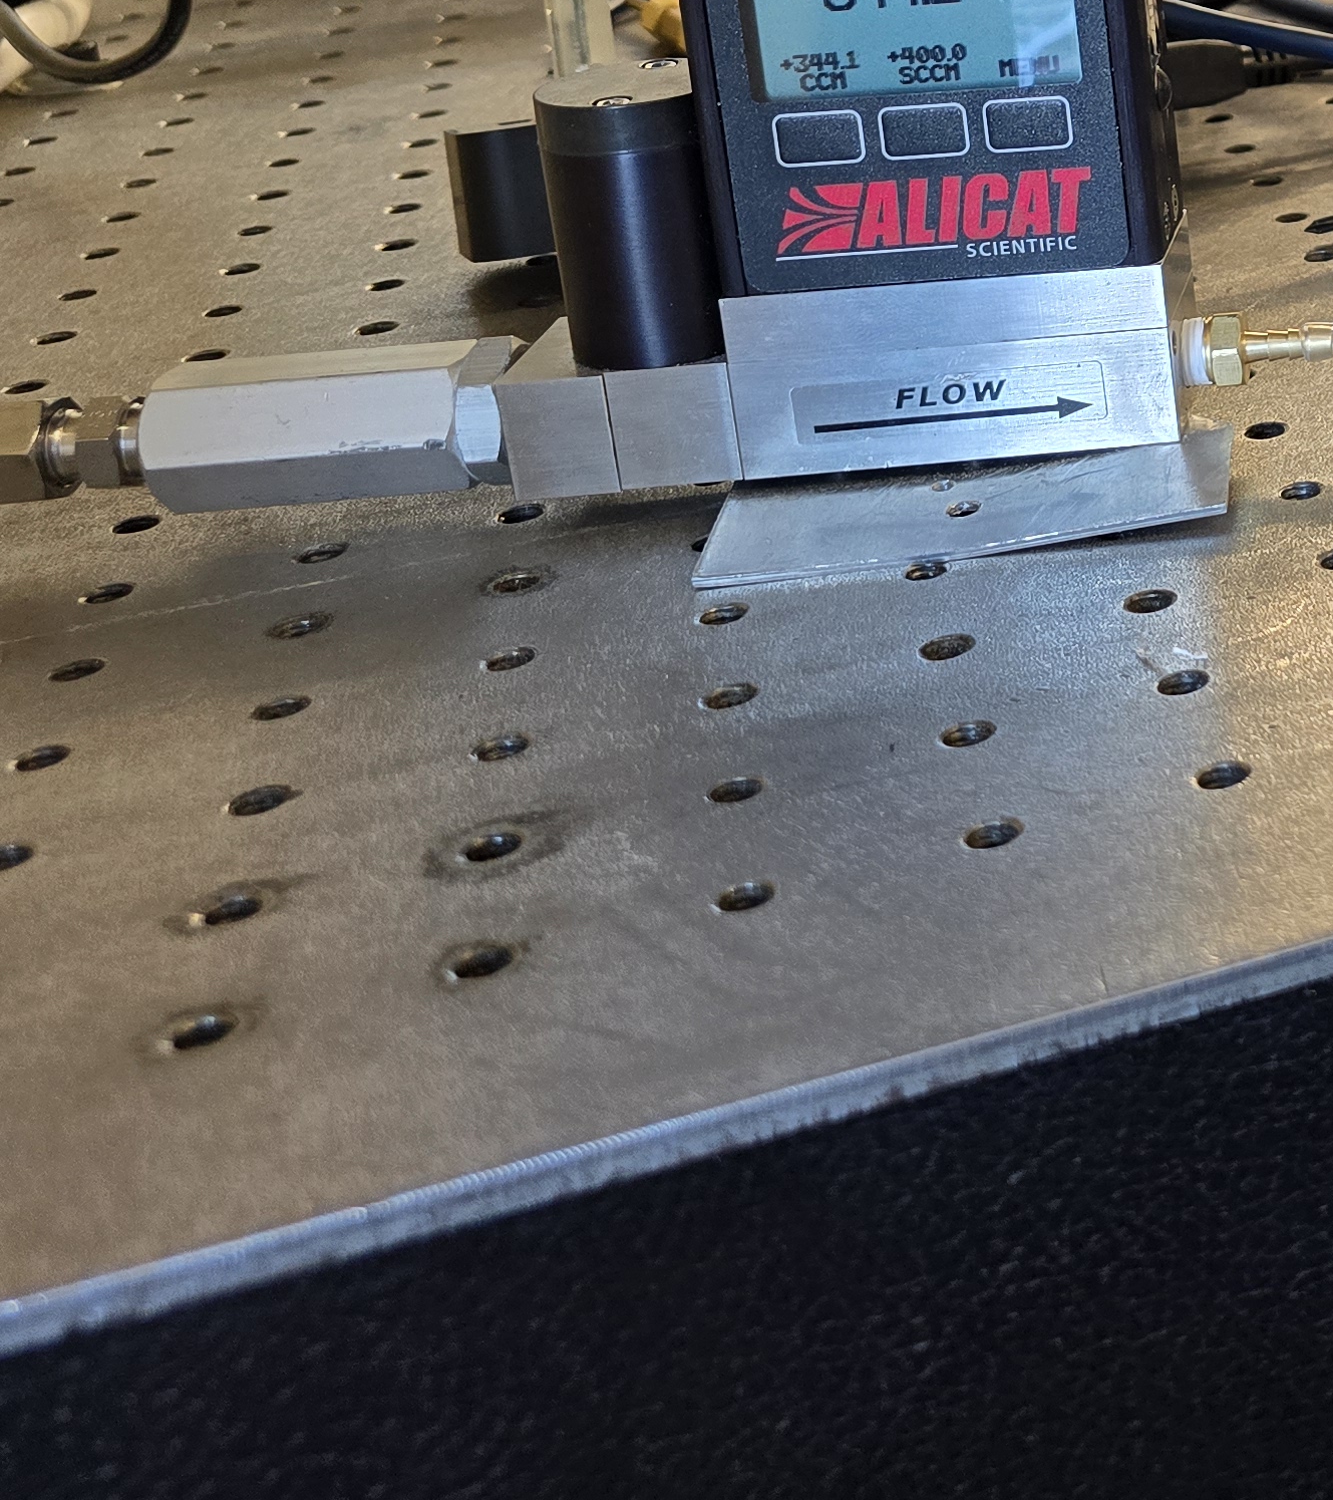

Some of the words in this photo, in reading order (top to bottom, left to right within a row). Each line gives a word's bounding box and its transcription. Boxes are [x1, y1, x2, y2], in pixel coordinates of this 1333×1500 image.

[780, 51, 861, 73] +344.1
[886, 43, 968, 65] +400.0
[799, 71, 849, 92] CCM
[899, 63, 962, 85] SCCM
[998, 54, 1061, 78] MENU
[856, 166, 1092, 248] ALICAT
[965, 235, 1078, 258] SCIENTIFIC
[894, 378, 1007, 410] FLOW
